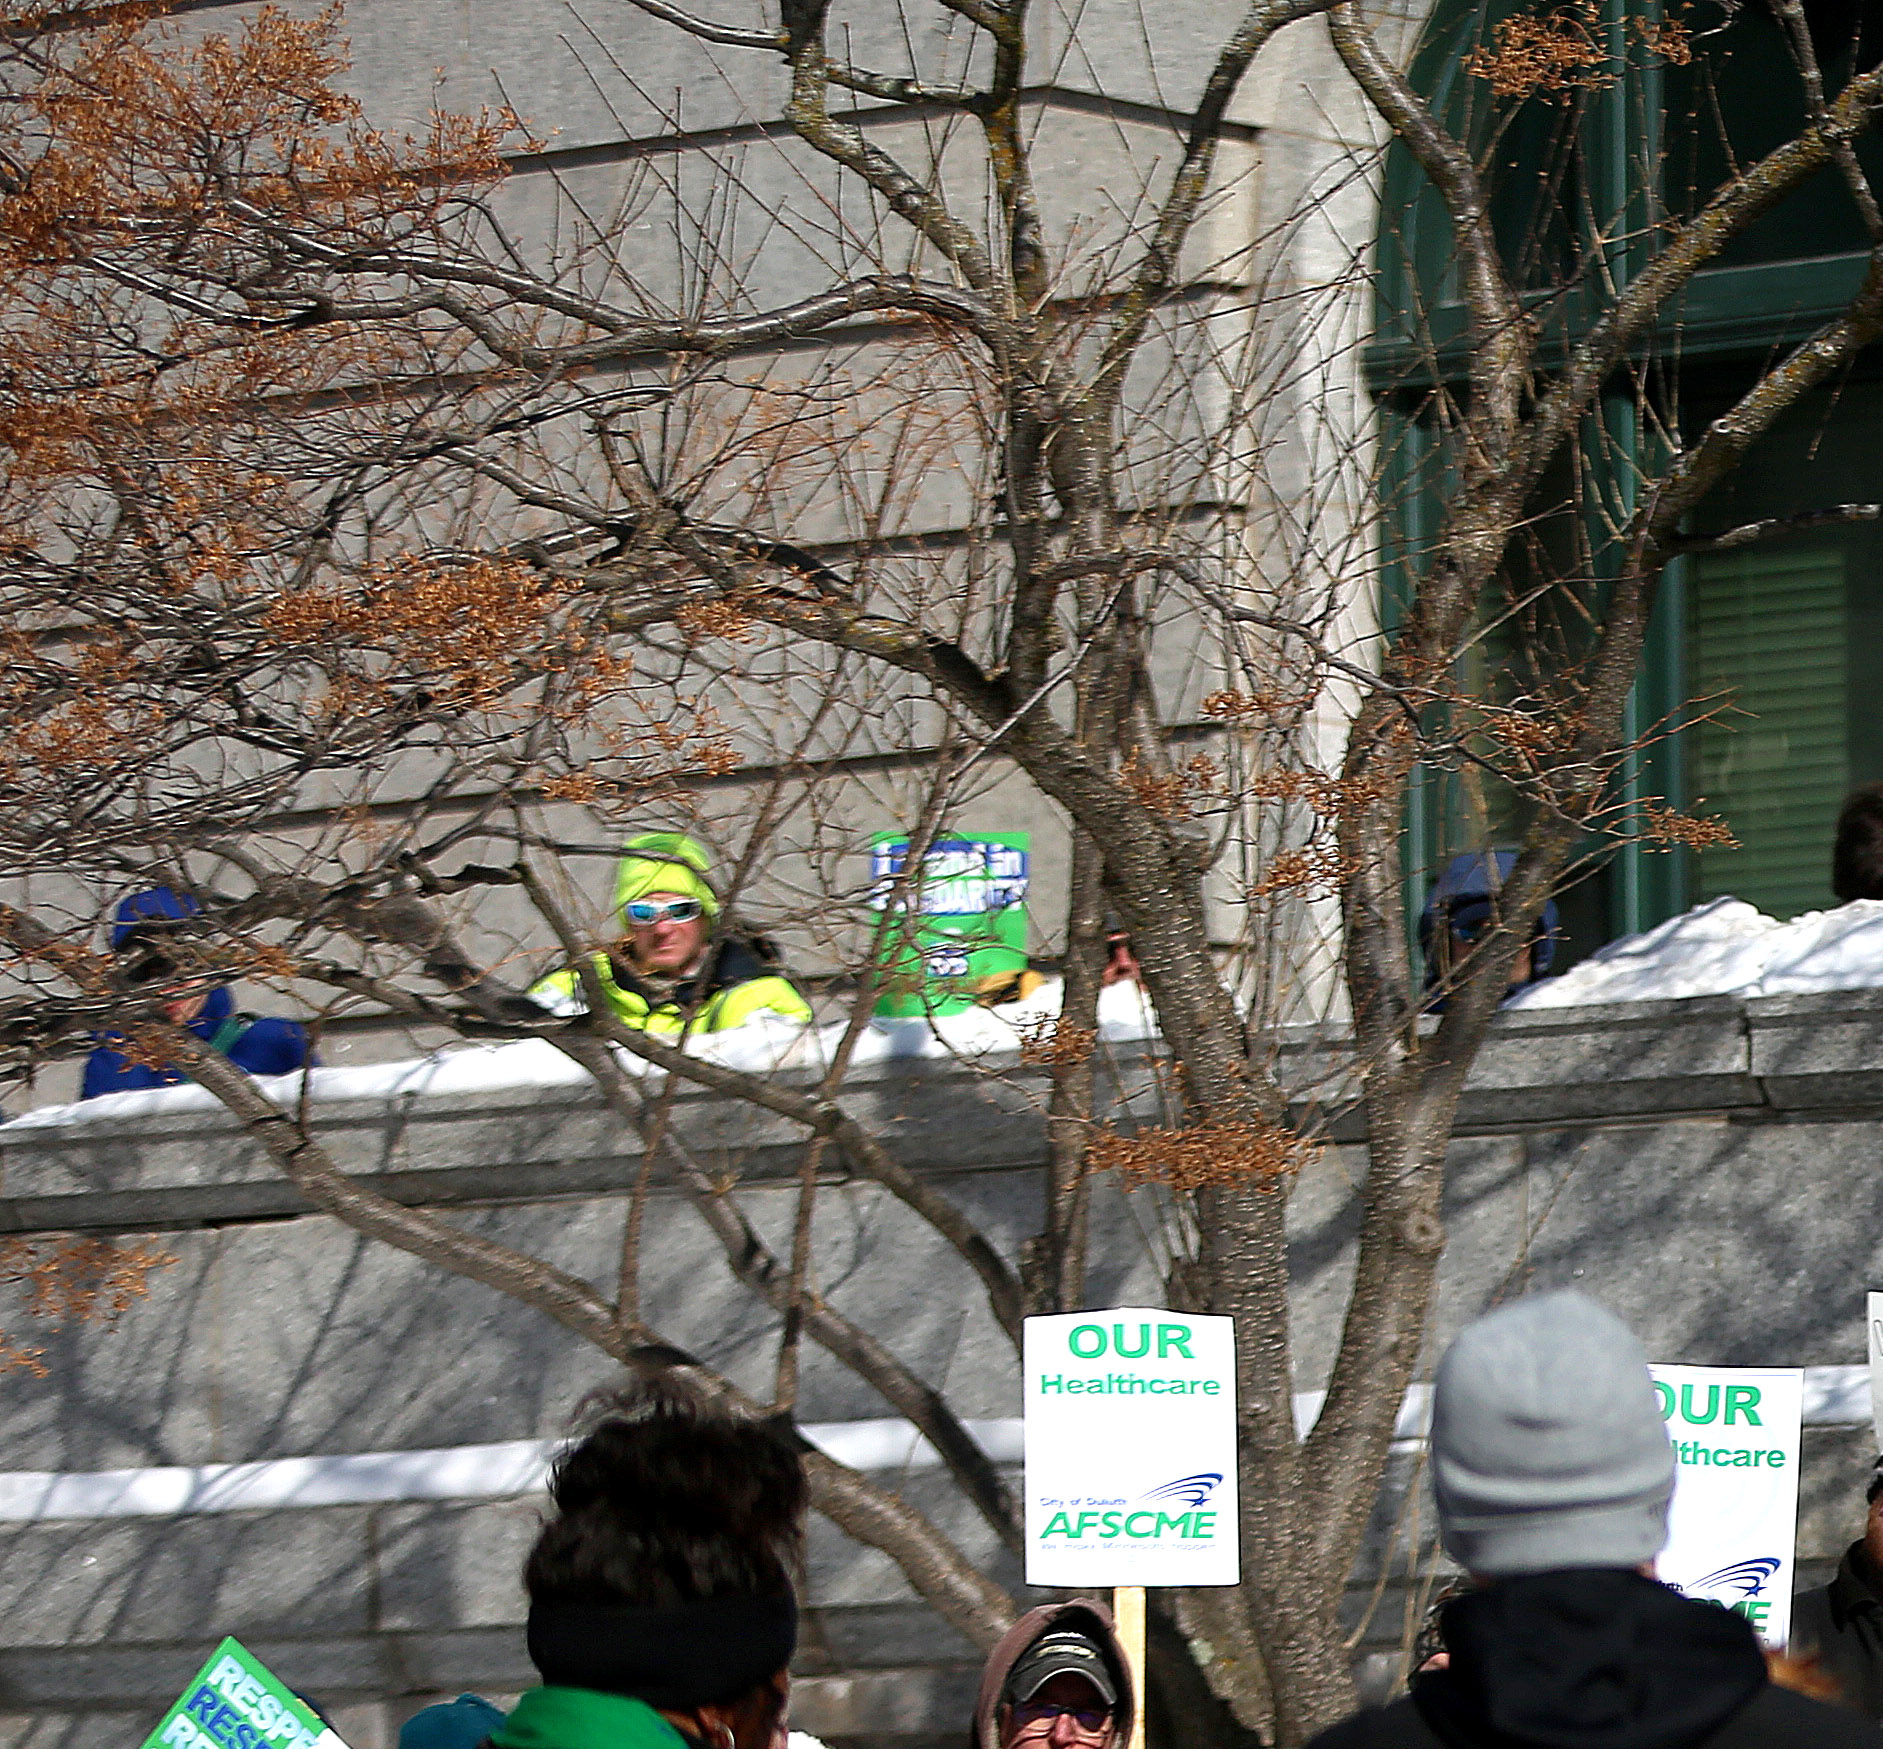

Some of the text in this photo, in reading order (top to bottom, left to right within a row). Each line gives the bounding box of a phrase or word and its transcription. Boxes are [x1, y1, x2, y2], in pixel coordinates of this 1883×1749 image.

[1068, 1323, 1196, 1359] OUR
[1040, 1374, 1221, 1396] Healthcare
[1672, 1440, 1786, 1468] lthcare
[1040, 1511, 1217, 1539] AFSCME
